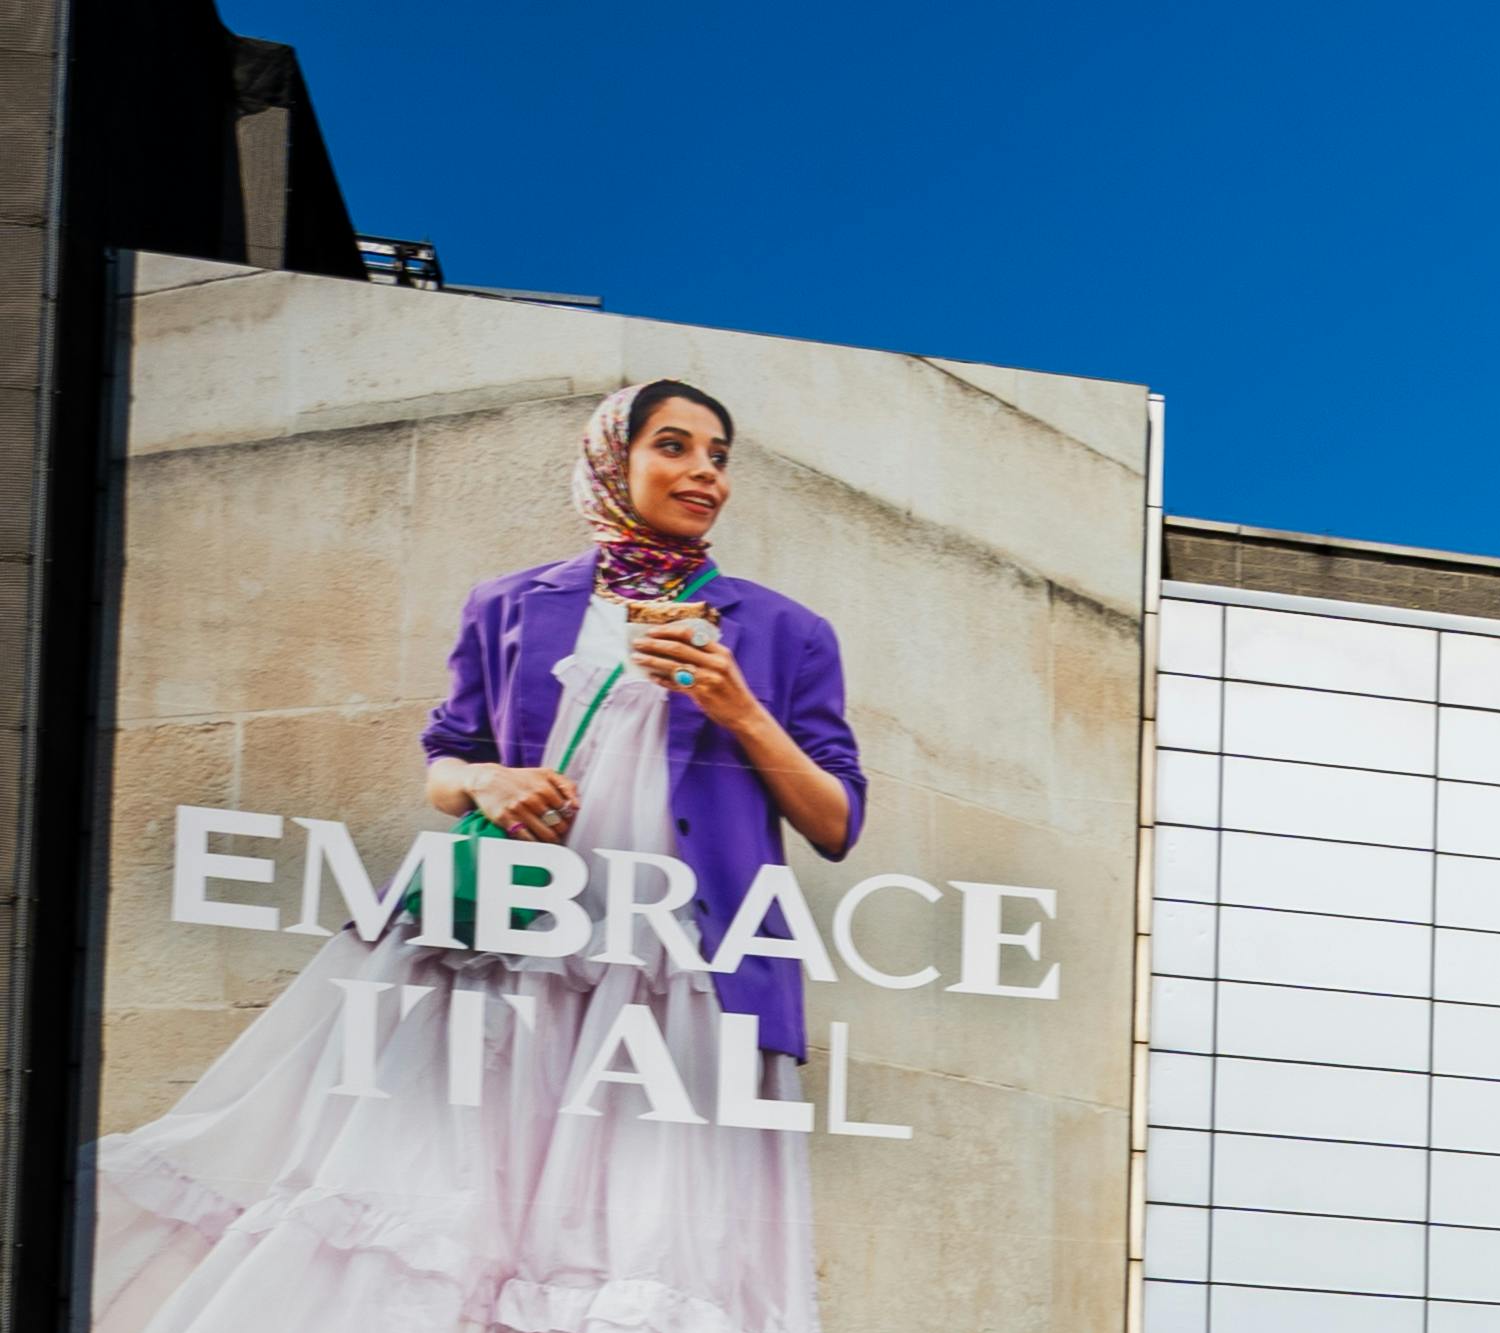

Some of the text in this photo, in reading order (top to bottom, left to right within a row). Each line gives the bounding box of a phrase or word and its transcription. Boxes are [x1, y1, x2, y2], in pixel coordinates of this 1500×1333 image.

[171, 804, 1060, 1000] EMBRACE
[328, 977, 914, 1139] IT ALL
